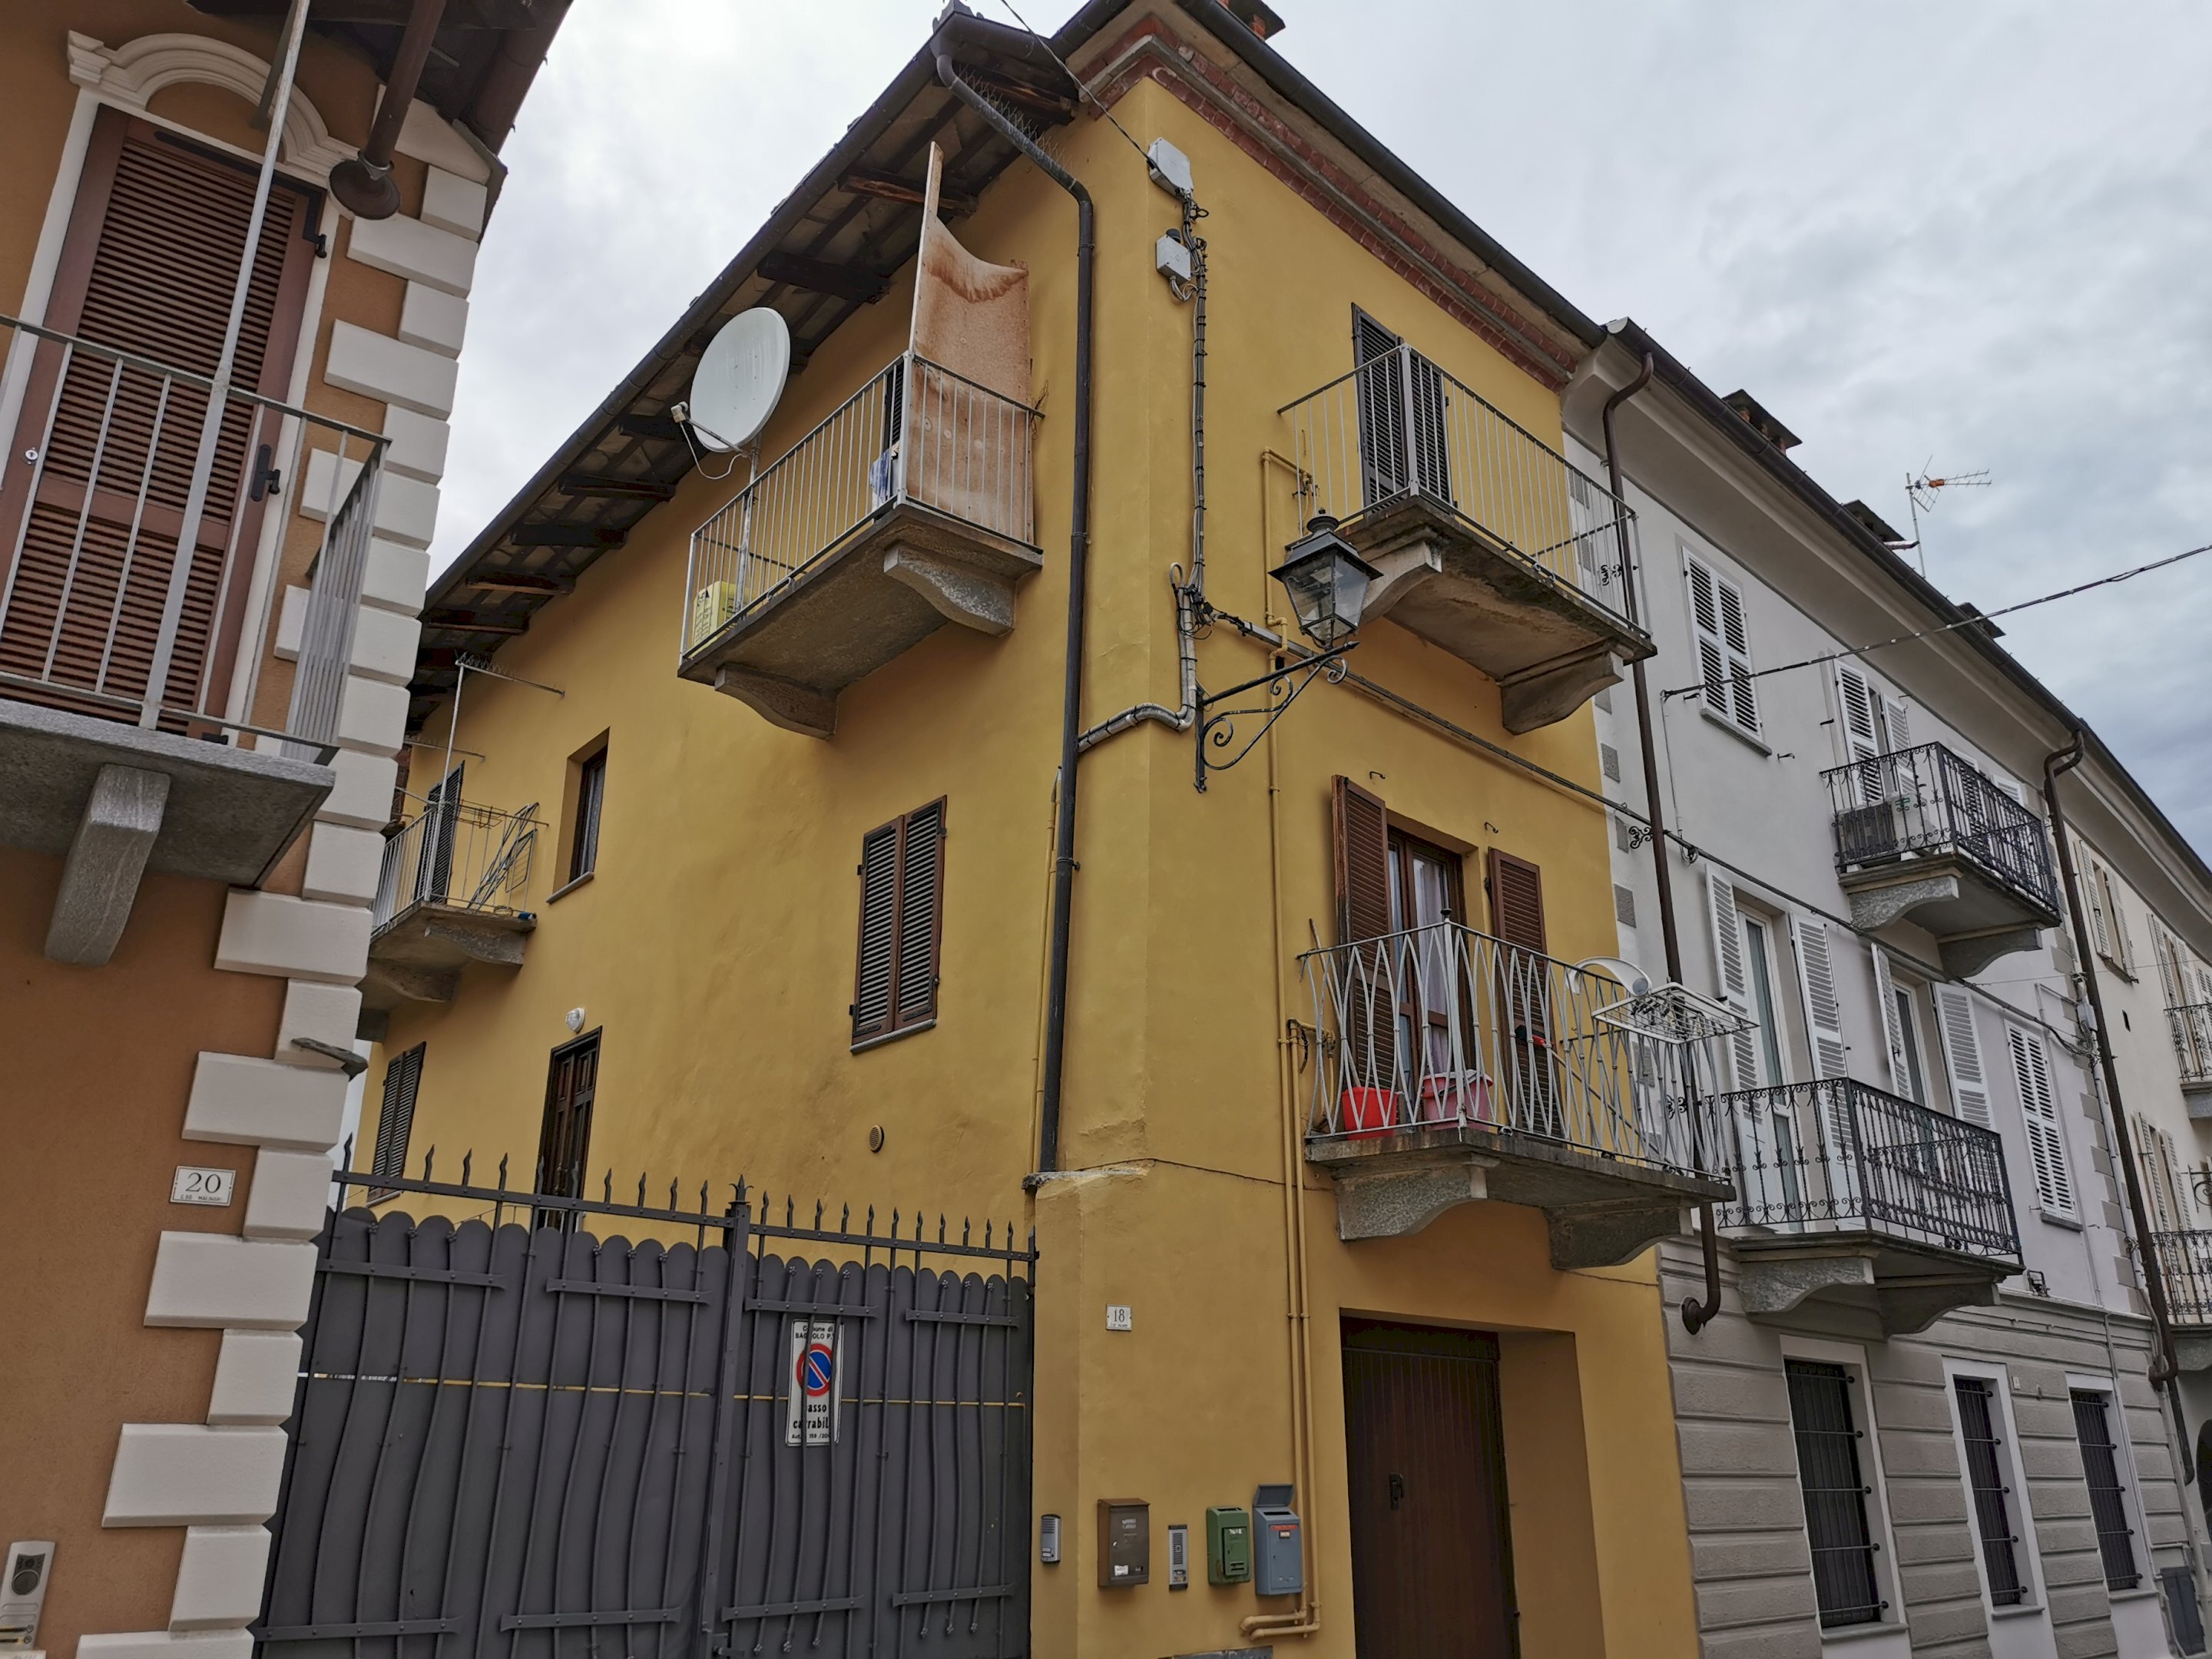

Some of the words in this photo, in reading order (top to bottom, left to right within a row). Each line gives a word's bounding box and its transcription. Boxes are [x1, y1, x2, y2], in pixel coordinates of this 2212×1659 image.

[185, 1172, 221, 1194] 20
[1114, 1308, 1125, 1322] 18
[806, 1404, 827, 1412] asso
[793, 1417, 830, 1429] carabil
